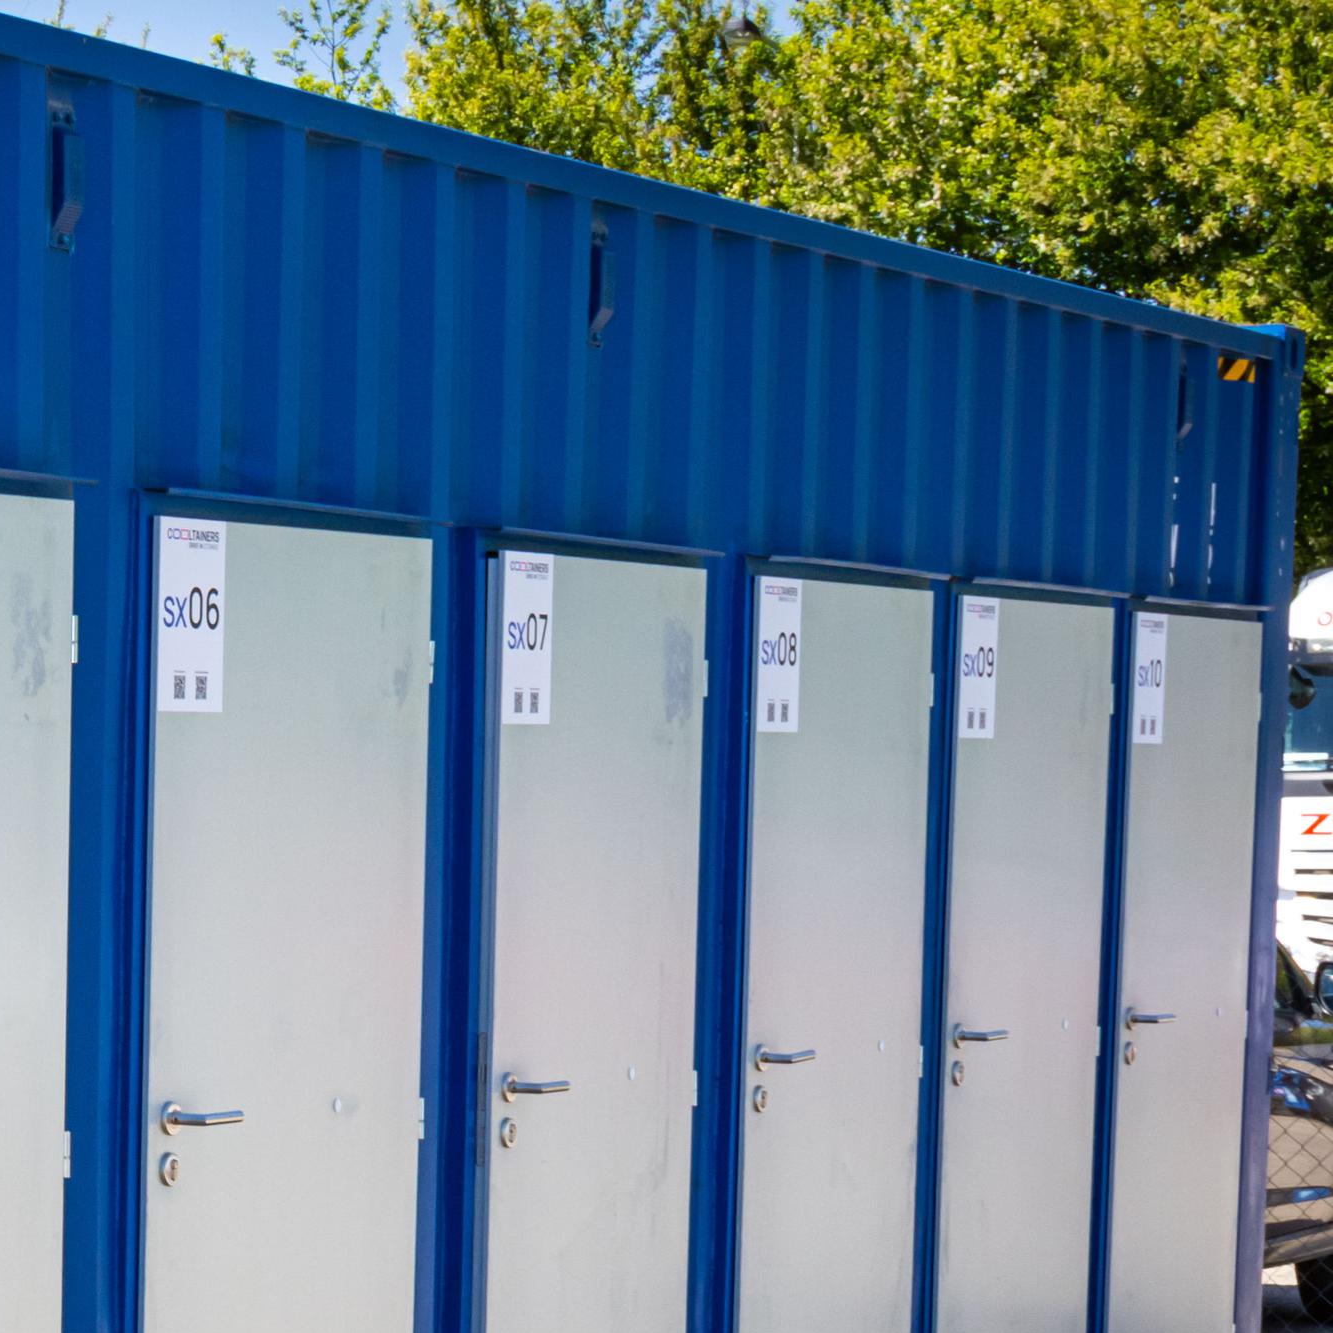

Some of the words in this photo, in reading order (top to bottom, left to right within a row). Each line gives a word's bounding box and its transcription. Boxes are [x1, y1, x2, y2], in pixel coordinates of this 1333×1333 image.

[163, 587, 219, 630] SX06
[508, 613, 548, 650] SX07
[761, 632, 797, 666] SX08
